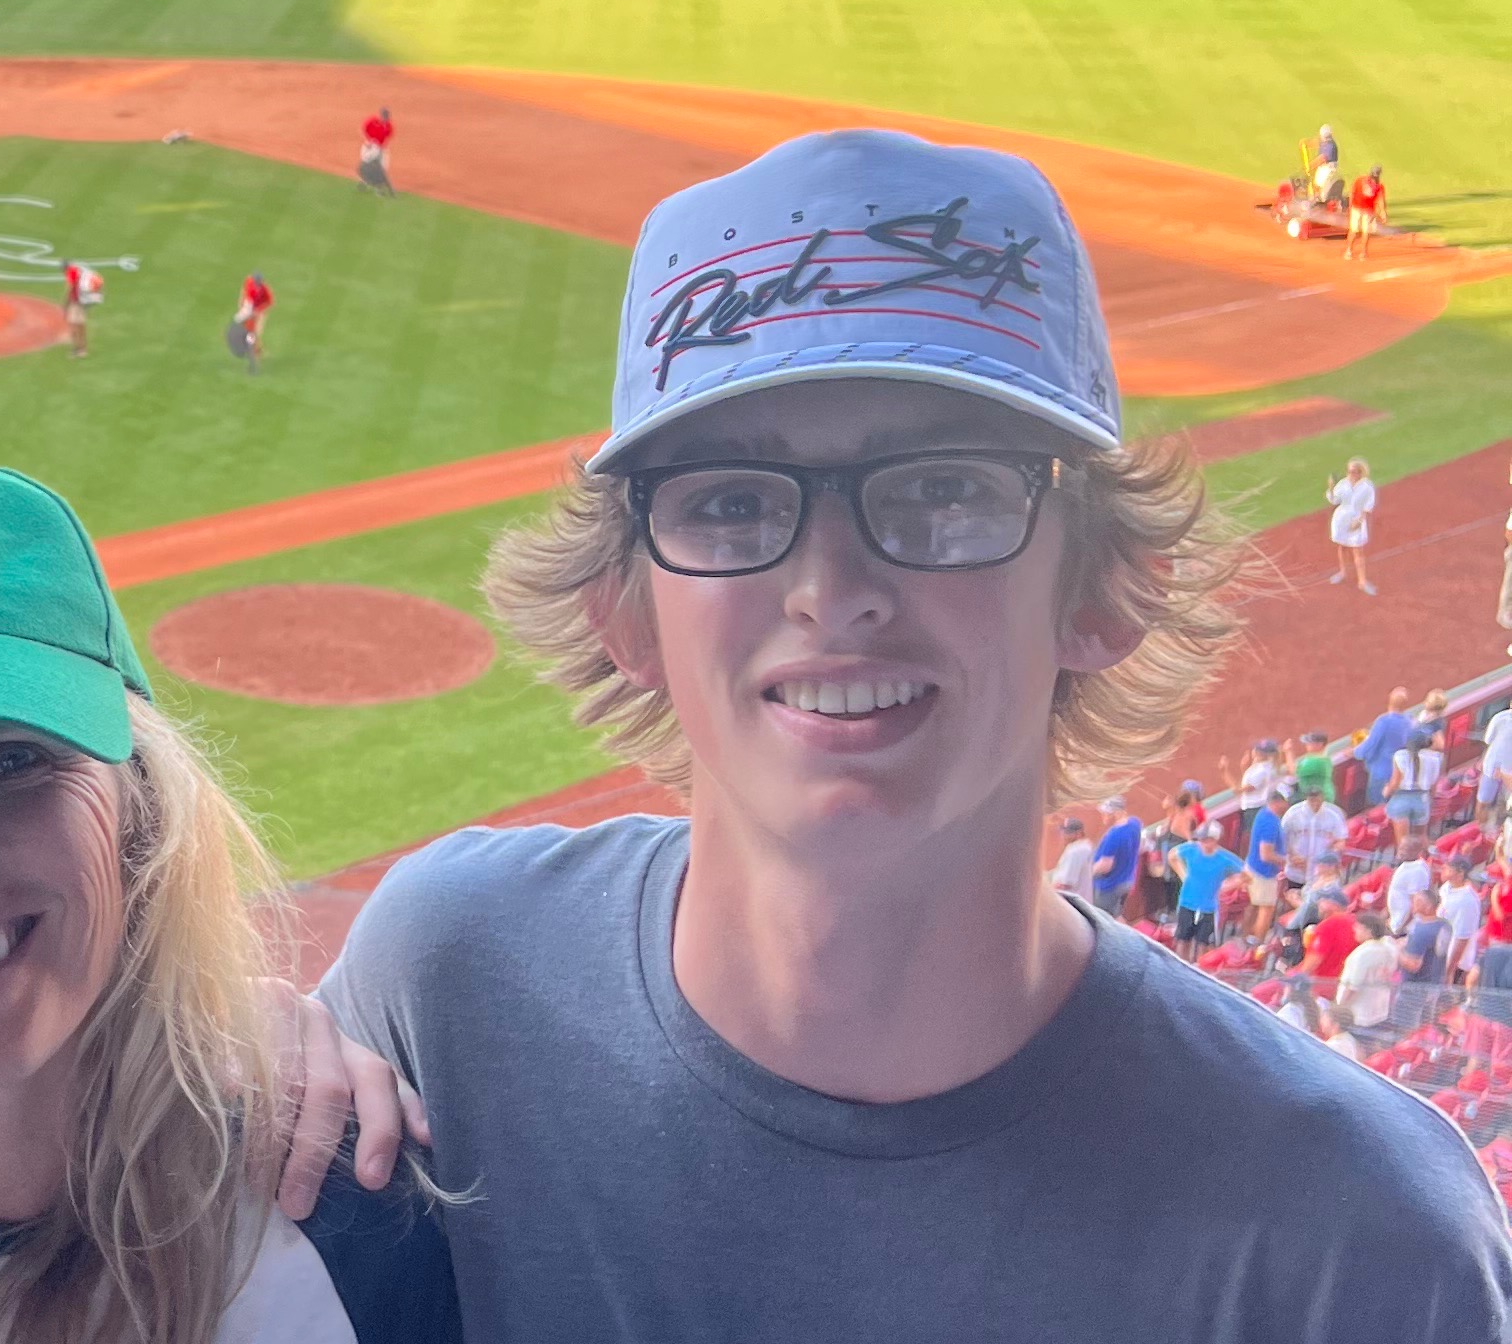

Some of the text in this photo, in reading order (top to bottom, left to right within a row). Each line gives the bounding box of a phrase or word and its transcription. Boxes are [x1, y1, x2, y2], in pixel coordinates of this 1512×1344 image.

[645, 196, 1042, 392] Red Sox
[668, 205, 1016, 268] BOSTN
